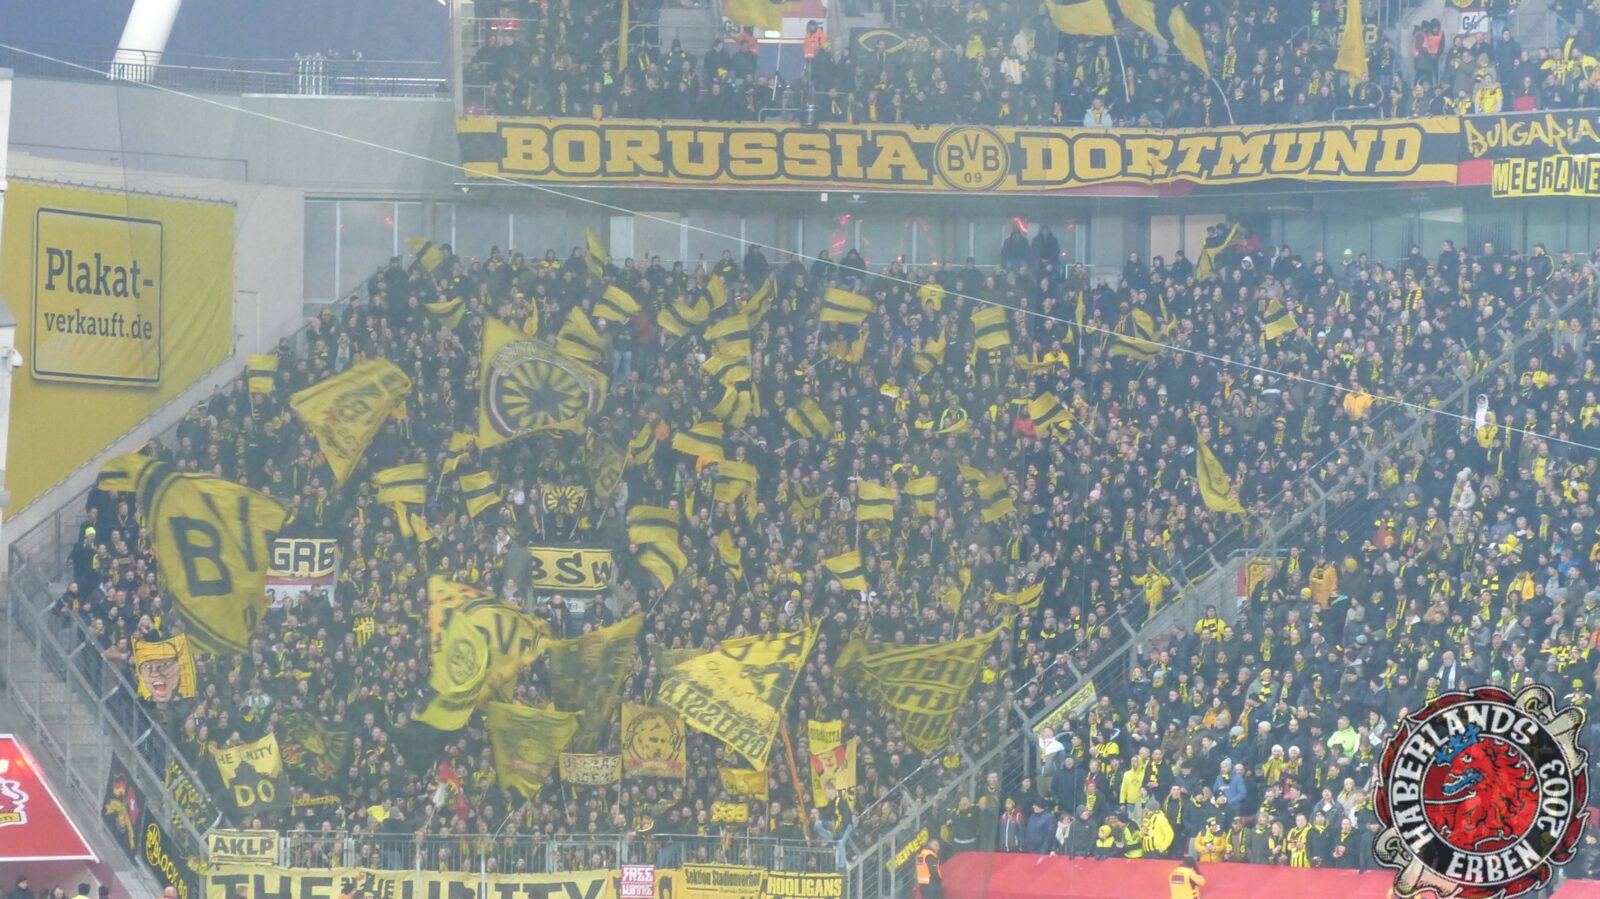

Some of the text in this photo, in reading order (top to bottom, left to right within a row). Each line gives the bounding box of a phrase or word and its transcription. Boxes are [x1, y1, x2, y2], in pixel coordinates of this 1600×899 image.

[501, 127, 928, 179] BORUSSIA
[946, 134, 999, 171] BVB
[1020, 127, 1421, 181] DORTMUND
[964, 172, 982, 183] 09
[1494, 160, 1600, 194] MEERANE
[45, 248, 153, 299] Plakat-
[44, 309, 153, 340] verkauft.de
[531, 552, 612, 584] BSW
[245, 744, 273, 761] NITY
[234, 779, 276, 808] DO
[213, 838, 274, 856] AKLP
[622, 867, 654, 882] FREE
[767, 877, 842, 896] HOOLIGANS
